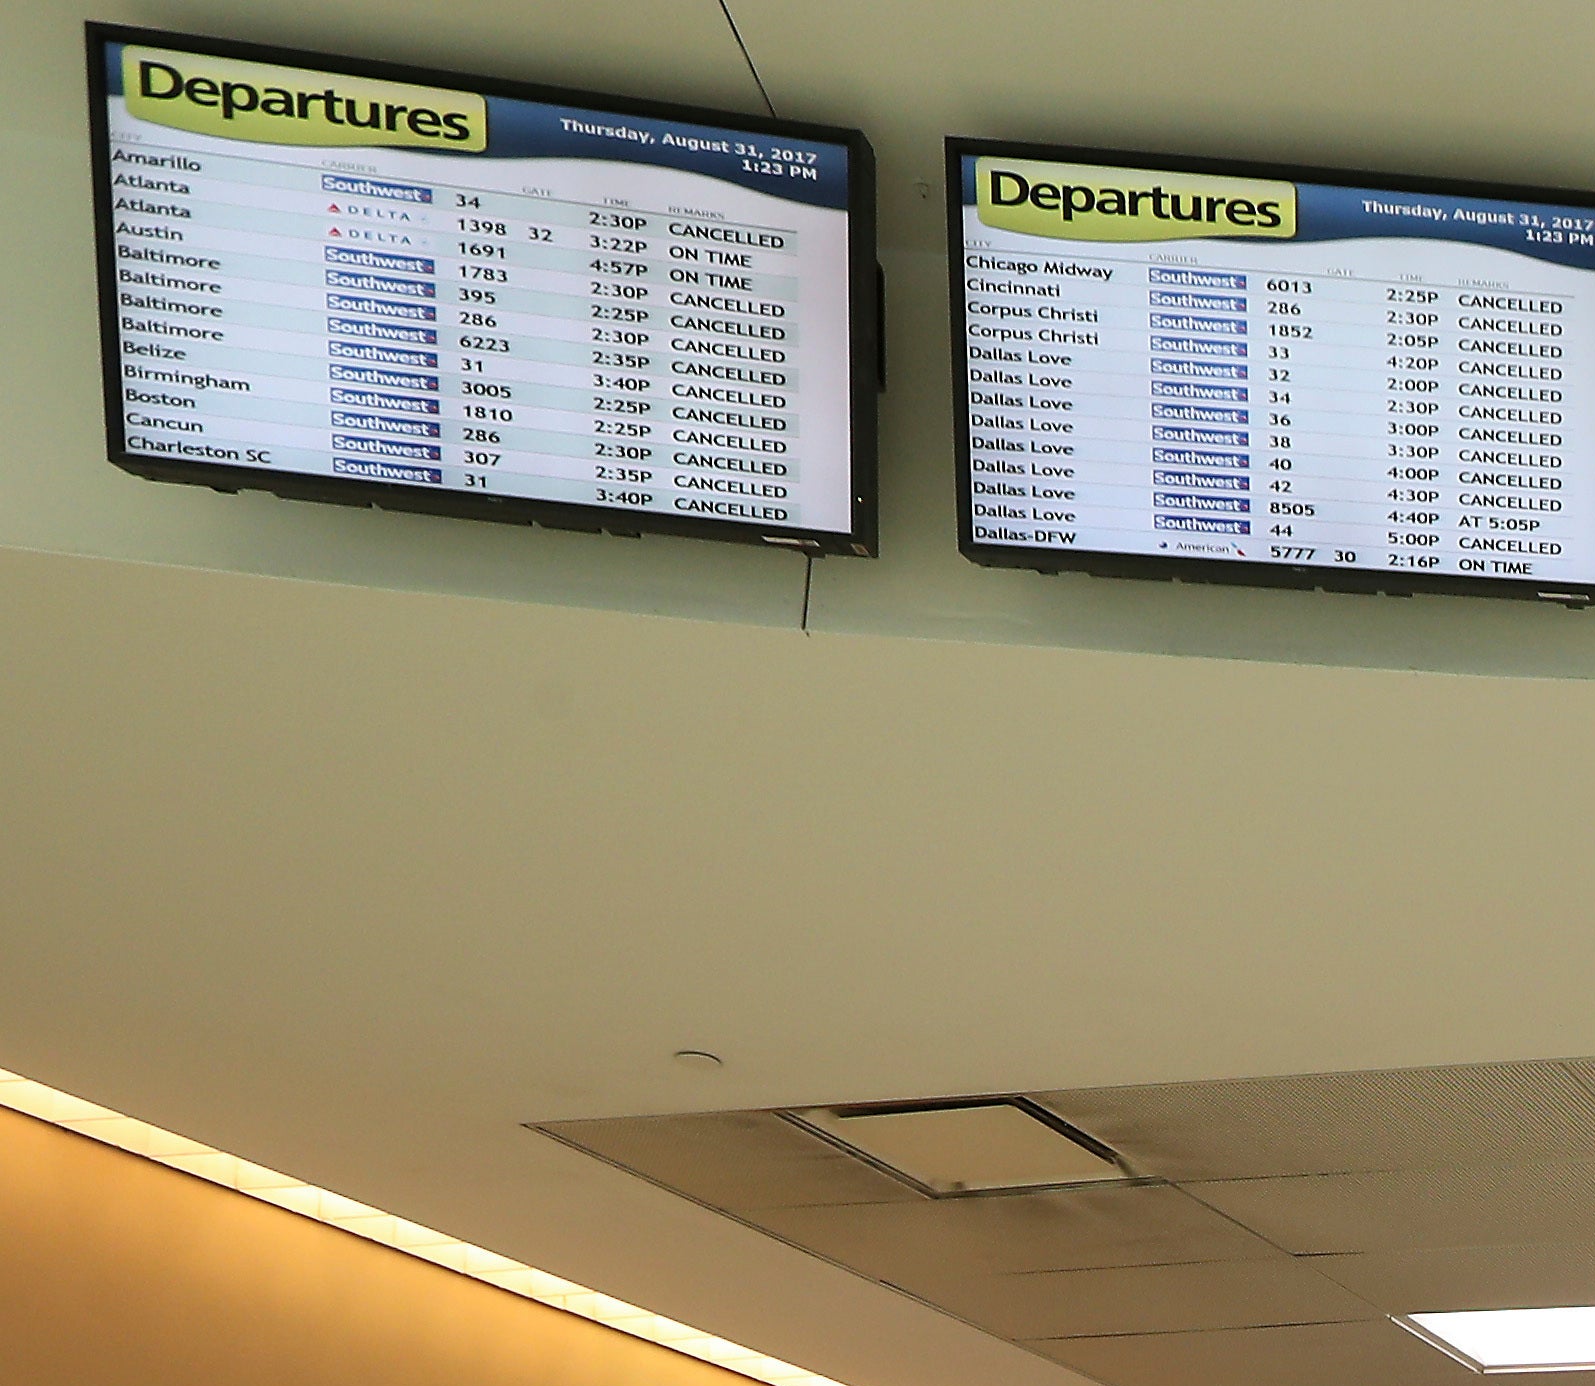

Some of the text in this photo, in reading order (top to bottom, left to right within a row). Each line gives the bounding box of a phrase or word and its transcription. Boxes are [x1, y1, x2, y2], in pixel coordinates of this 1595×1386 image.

[139, 60, 471, 141] Departures
[560, 117, 818, 166] Thursday, August 31, 2017
[741, 158, 818, 182] 1:23 PM
[989, 170, 1282, 227] Departures
[1361, 199, 1595, 232] Thursday, August 31, 2017
[1525, 228, 1595, 247] 1:23 PM
